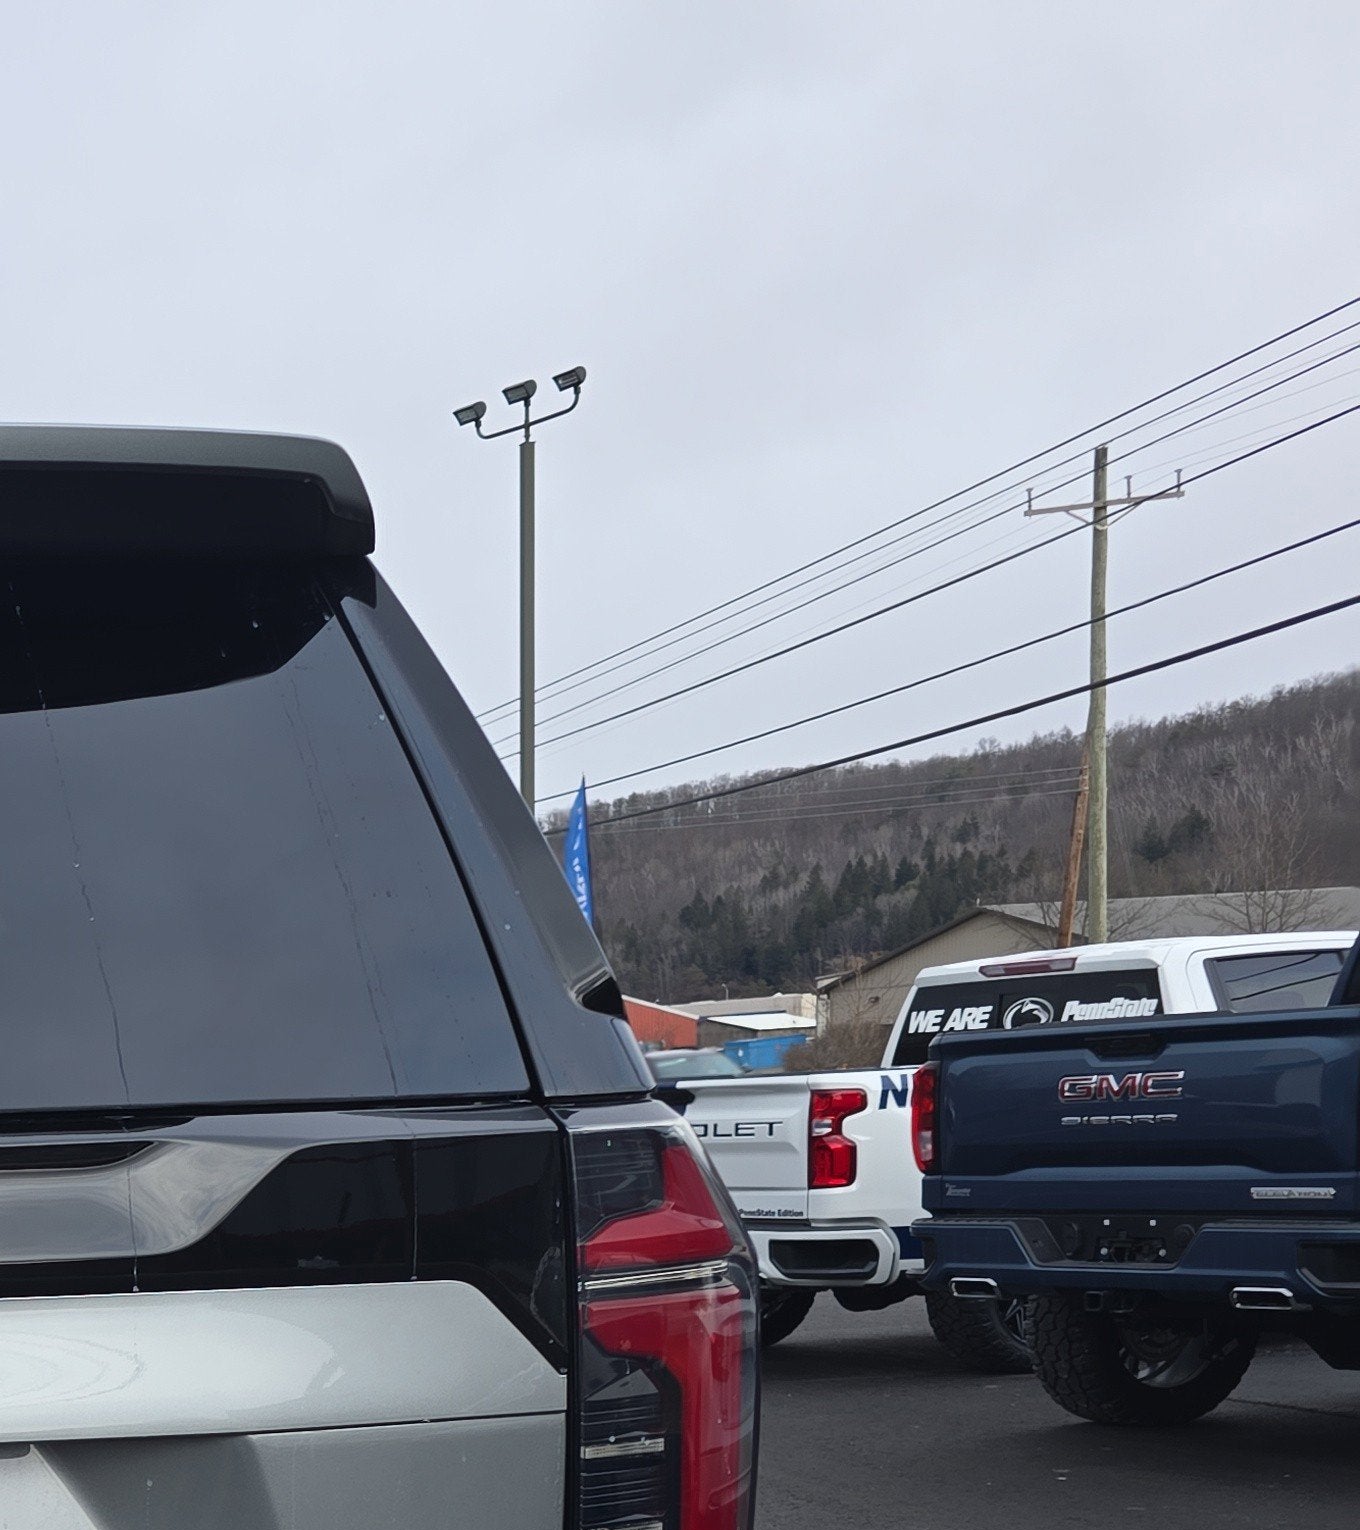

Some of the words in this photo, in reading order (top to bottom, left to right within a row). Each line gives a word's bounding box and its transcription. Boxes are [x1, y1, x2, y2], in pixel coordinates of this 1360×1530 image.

[908, 1009, 945, 1034] WE
[942, 1006, 994, 1031] ARE
[878, 1073, 909, 1110] N
[1058, 1070, 1185, 1104] GMC
[1061, 1113, 1178, 1126] SIERRA
[777, 1208, 804, 1217] Edition
